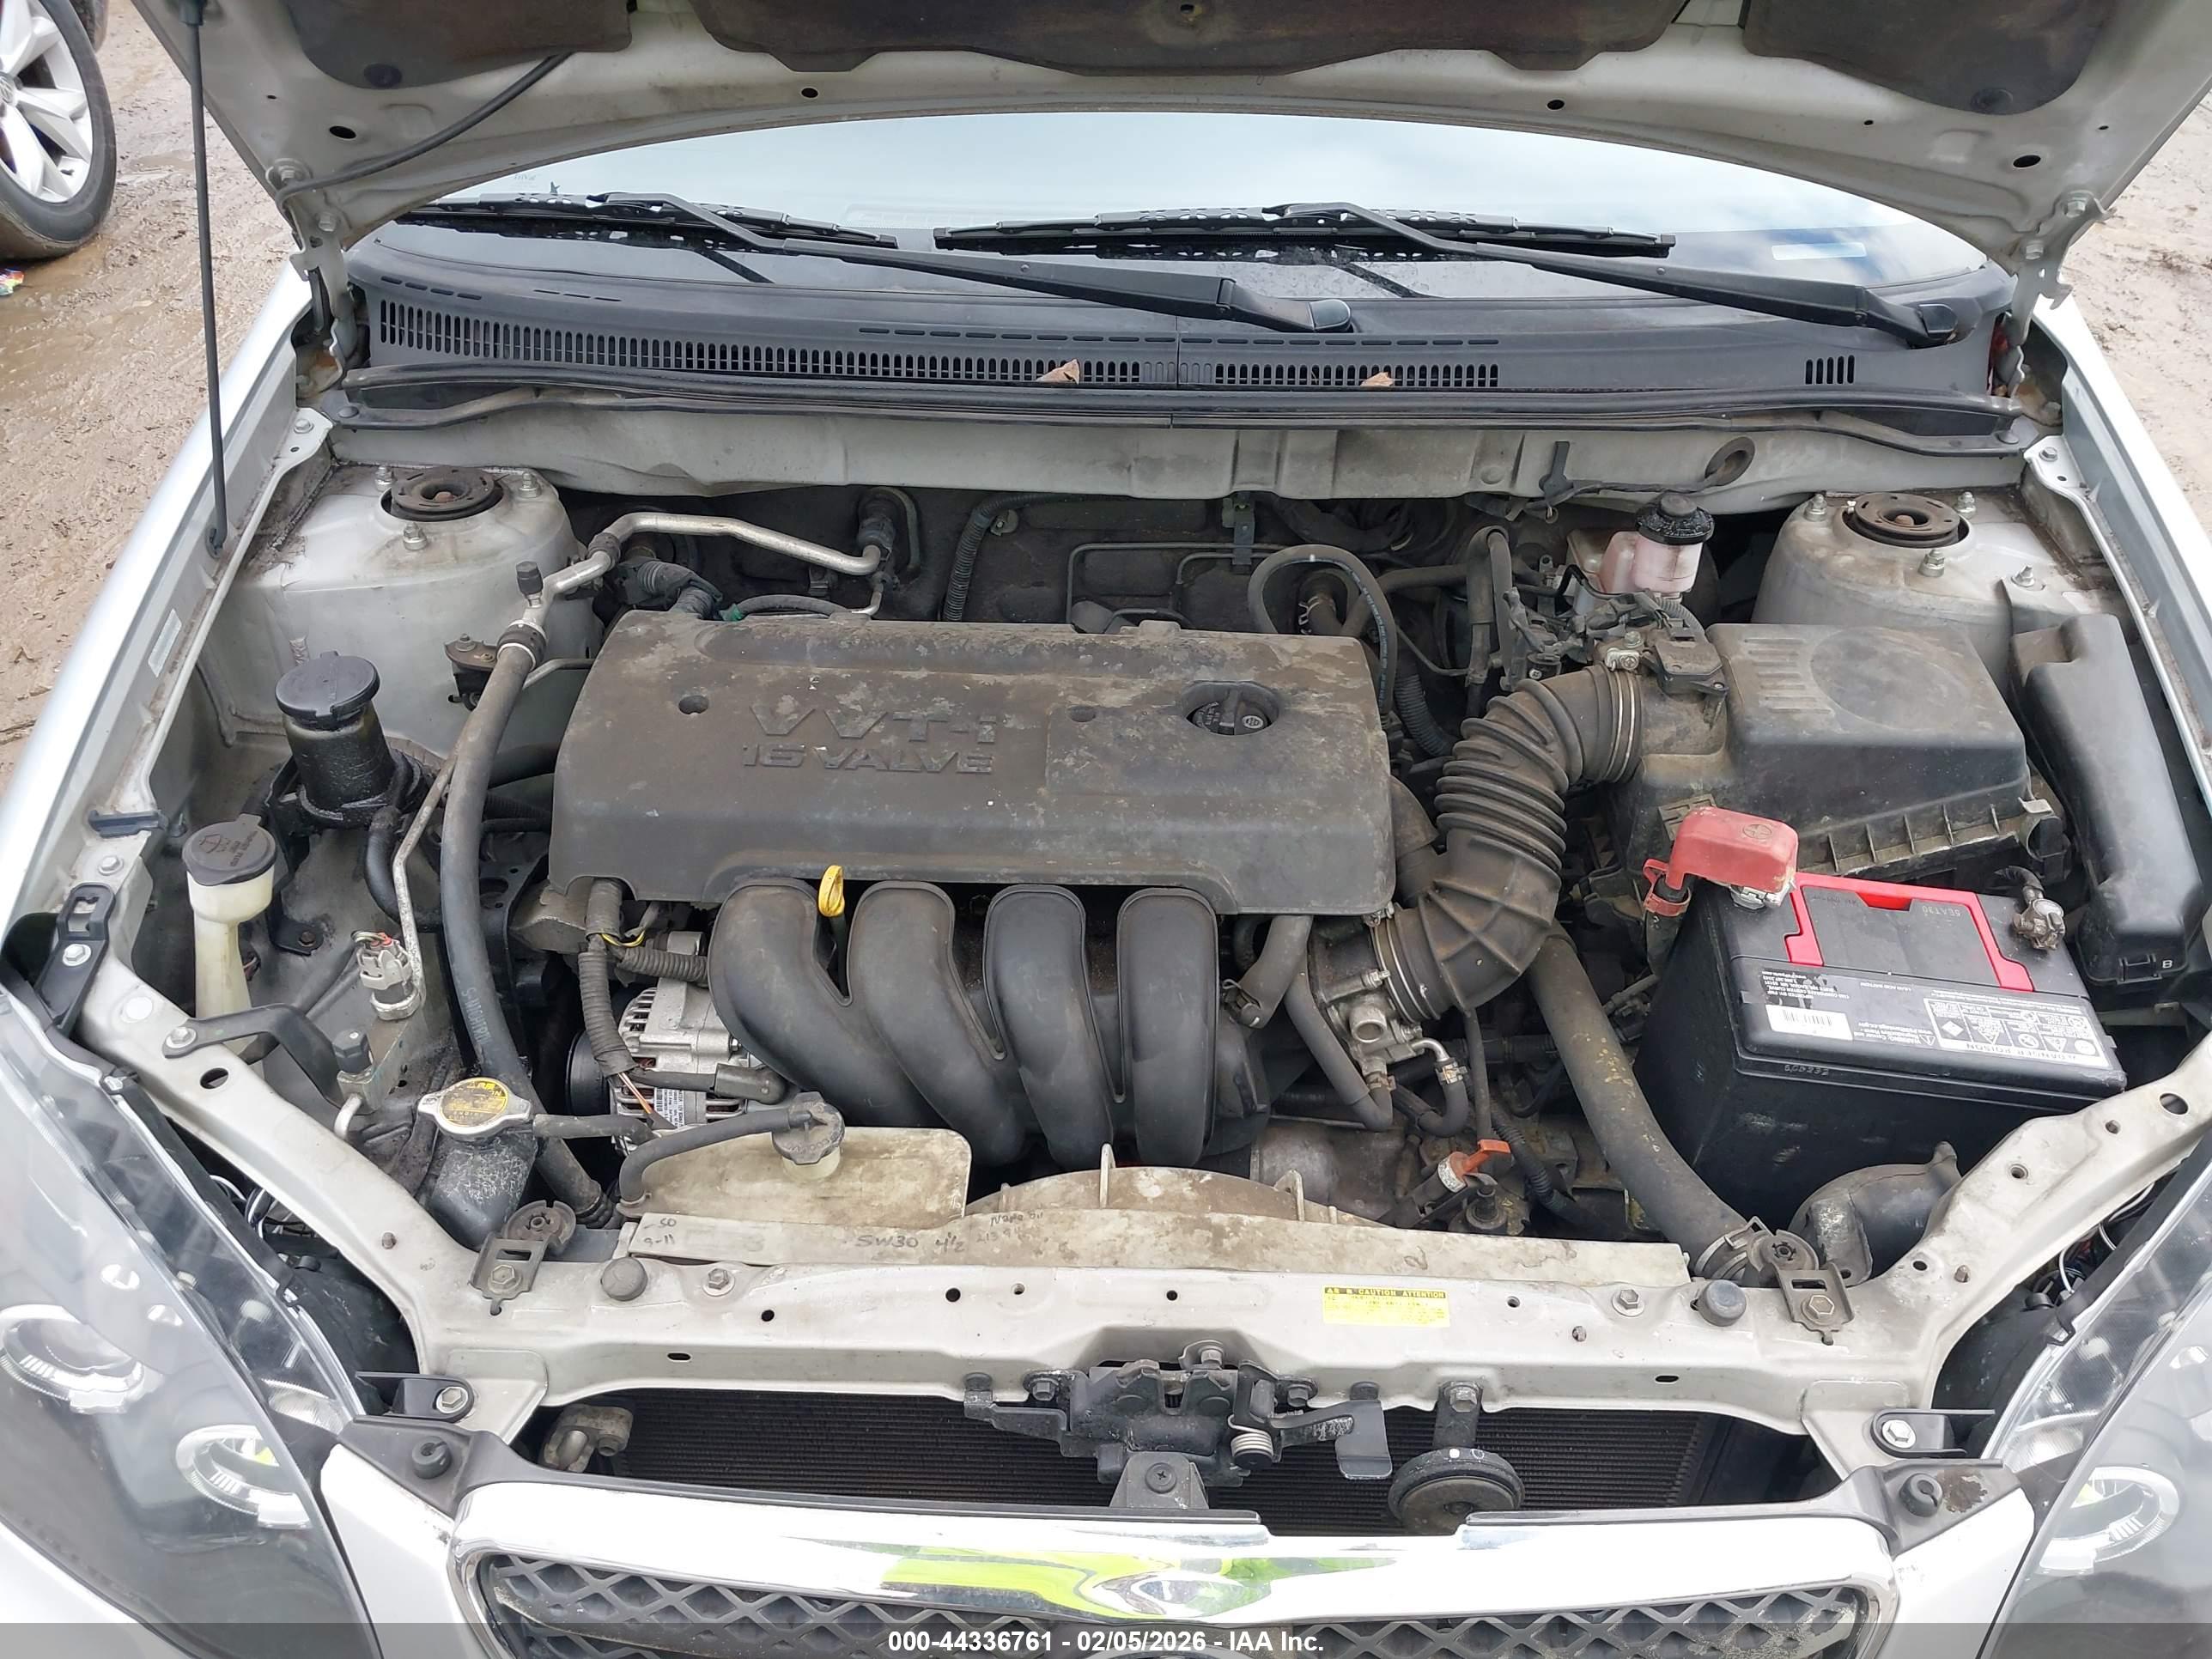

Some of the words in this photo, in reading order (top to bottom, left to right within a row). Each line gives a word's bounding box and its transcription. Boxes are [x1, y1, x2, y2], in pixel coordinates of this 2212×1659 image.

[743, 744, 806, 767] 16
[814, 747, 994, 774] VALVE
[2162, 958, 2172, 969] B
